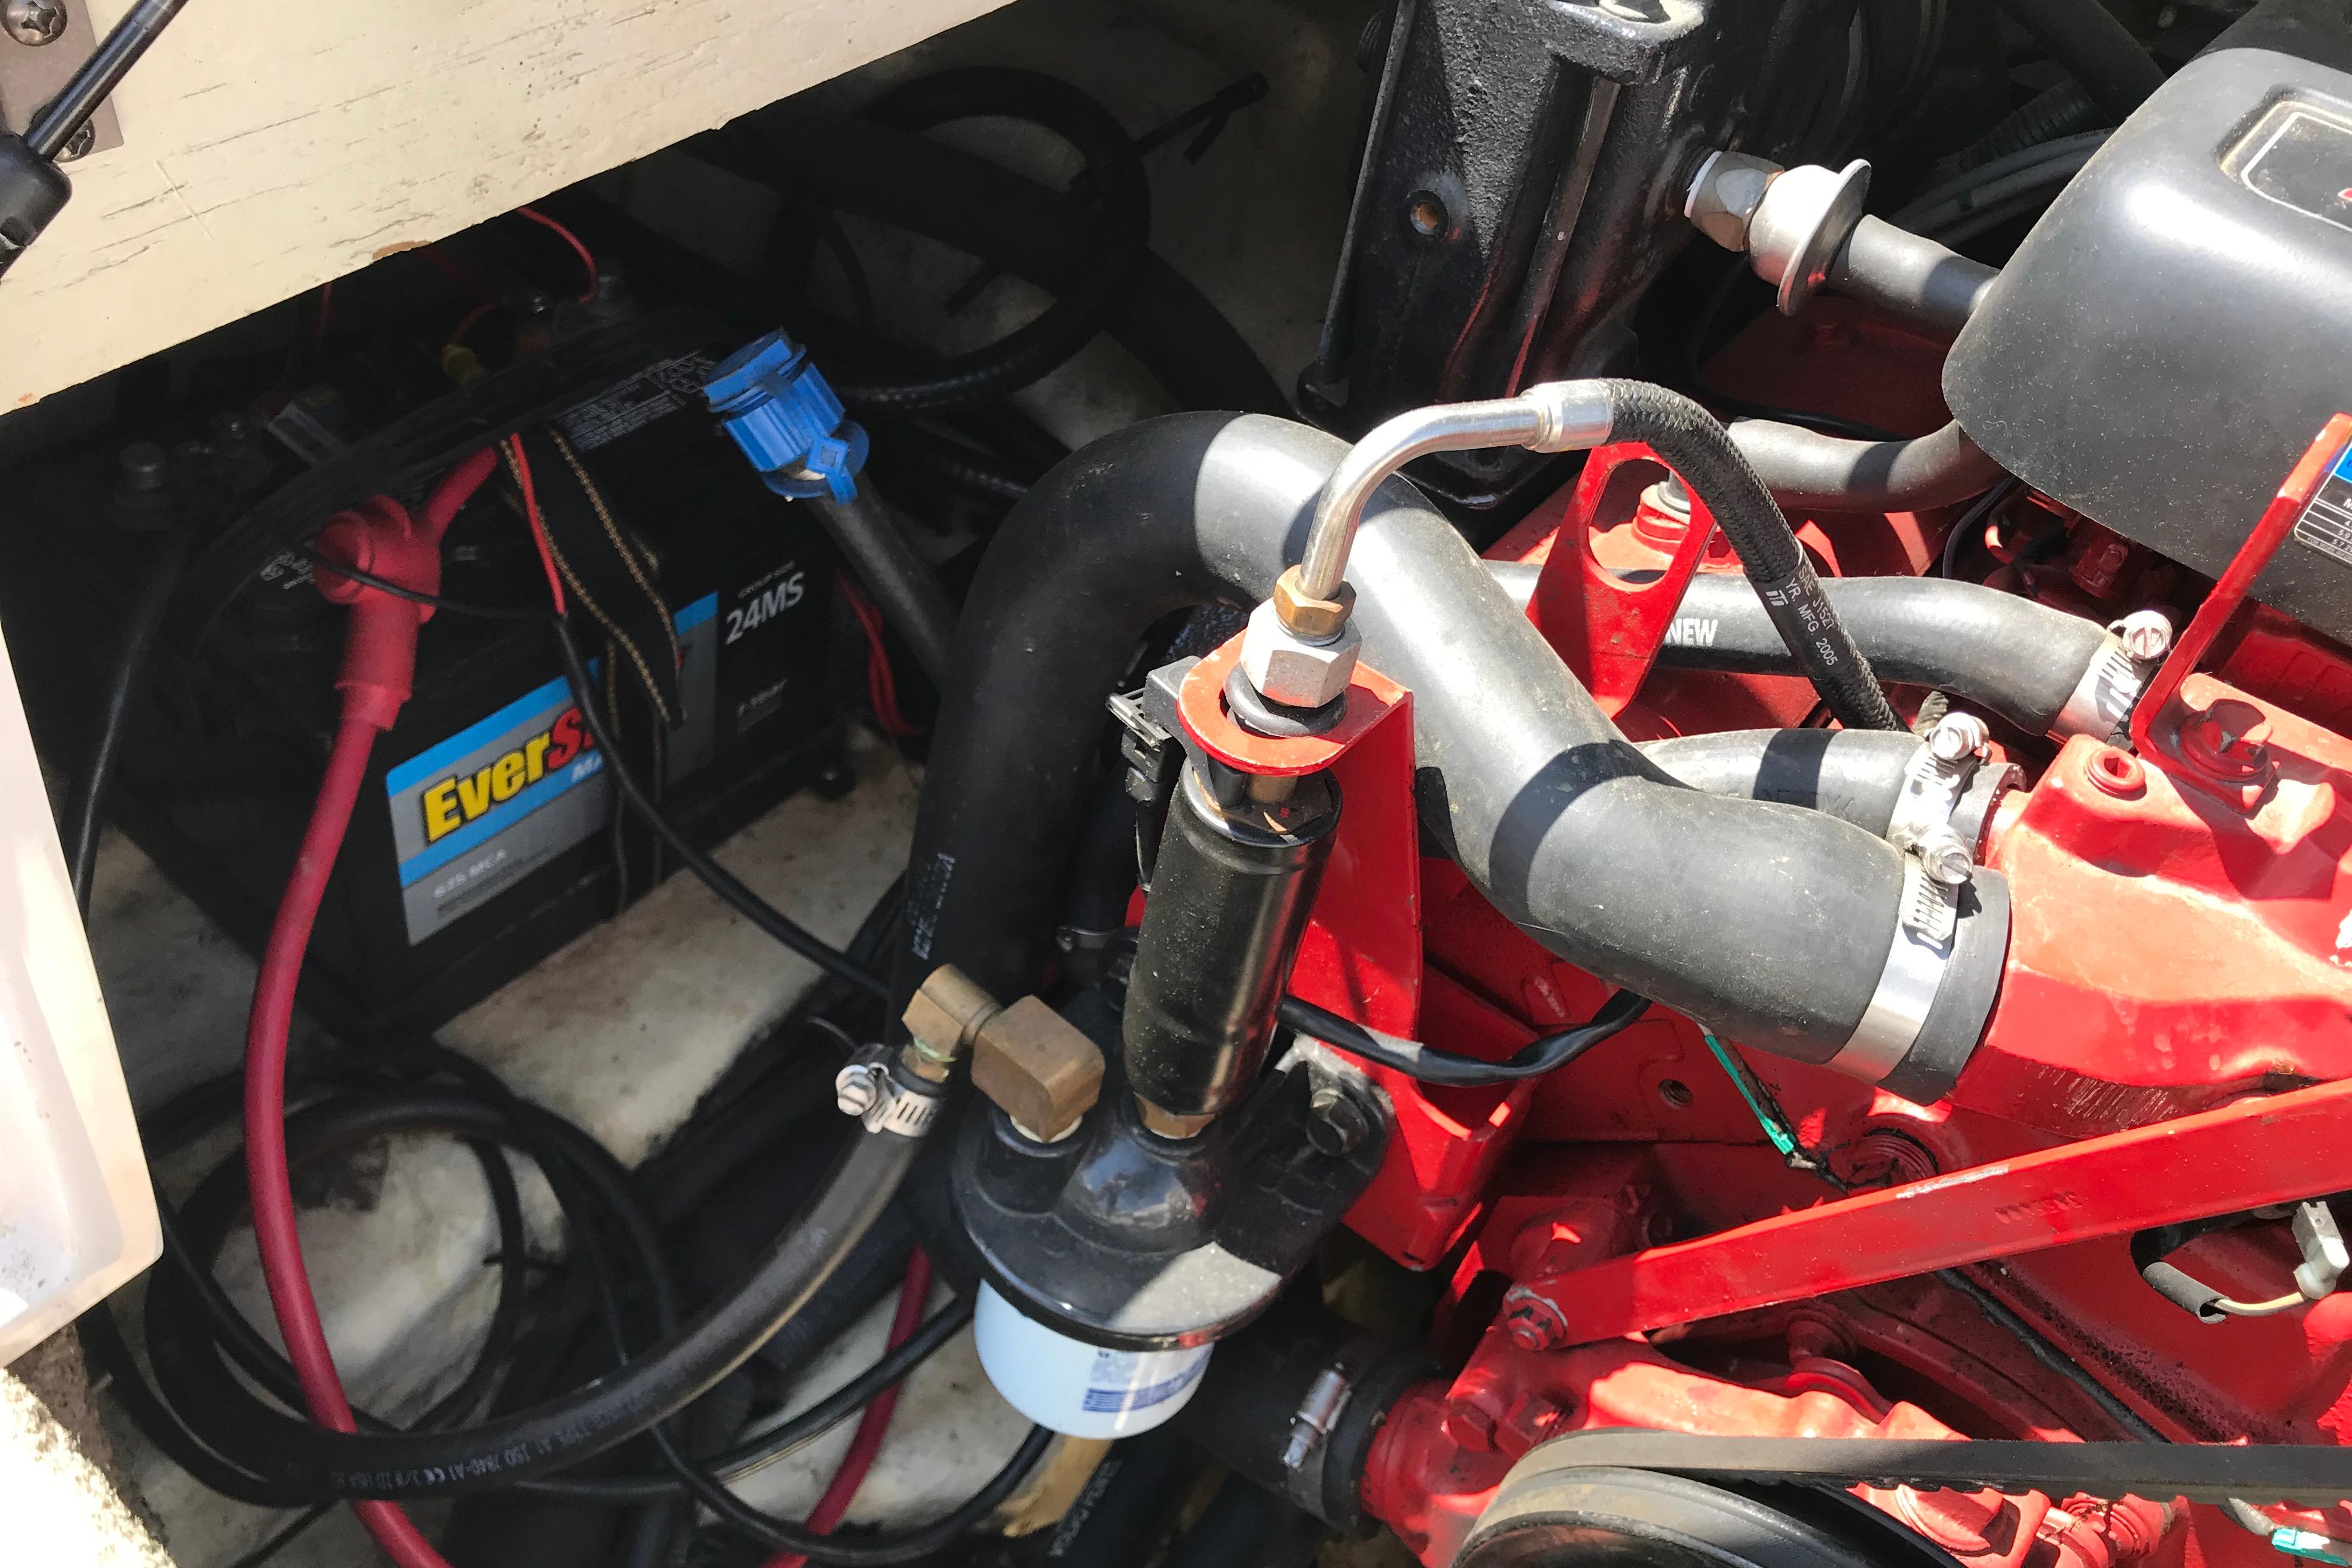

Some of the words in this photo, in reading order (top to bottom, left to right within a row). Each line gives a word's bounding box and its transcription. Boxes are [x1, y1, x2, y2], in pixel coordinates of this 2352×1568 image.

[726, 570, 805, 645] 24MS
[1665, 618, 1718, 647] NEW
[1785, 578, 1801, 602] YR.
[1798, 604, 1819, 636] MFG.
[1816, 638, 1838, 666] 2005
[1798, 565, 1815, 596] SAE
[1812, 596, 1835, 631] J1527
[424, 706, 596, 842] EverS
